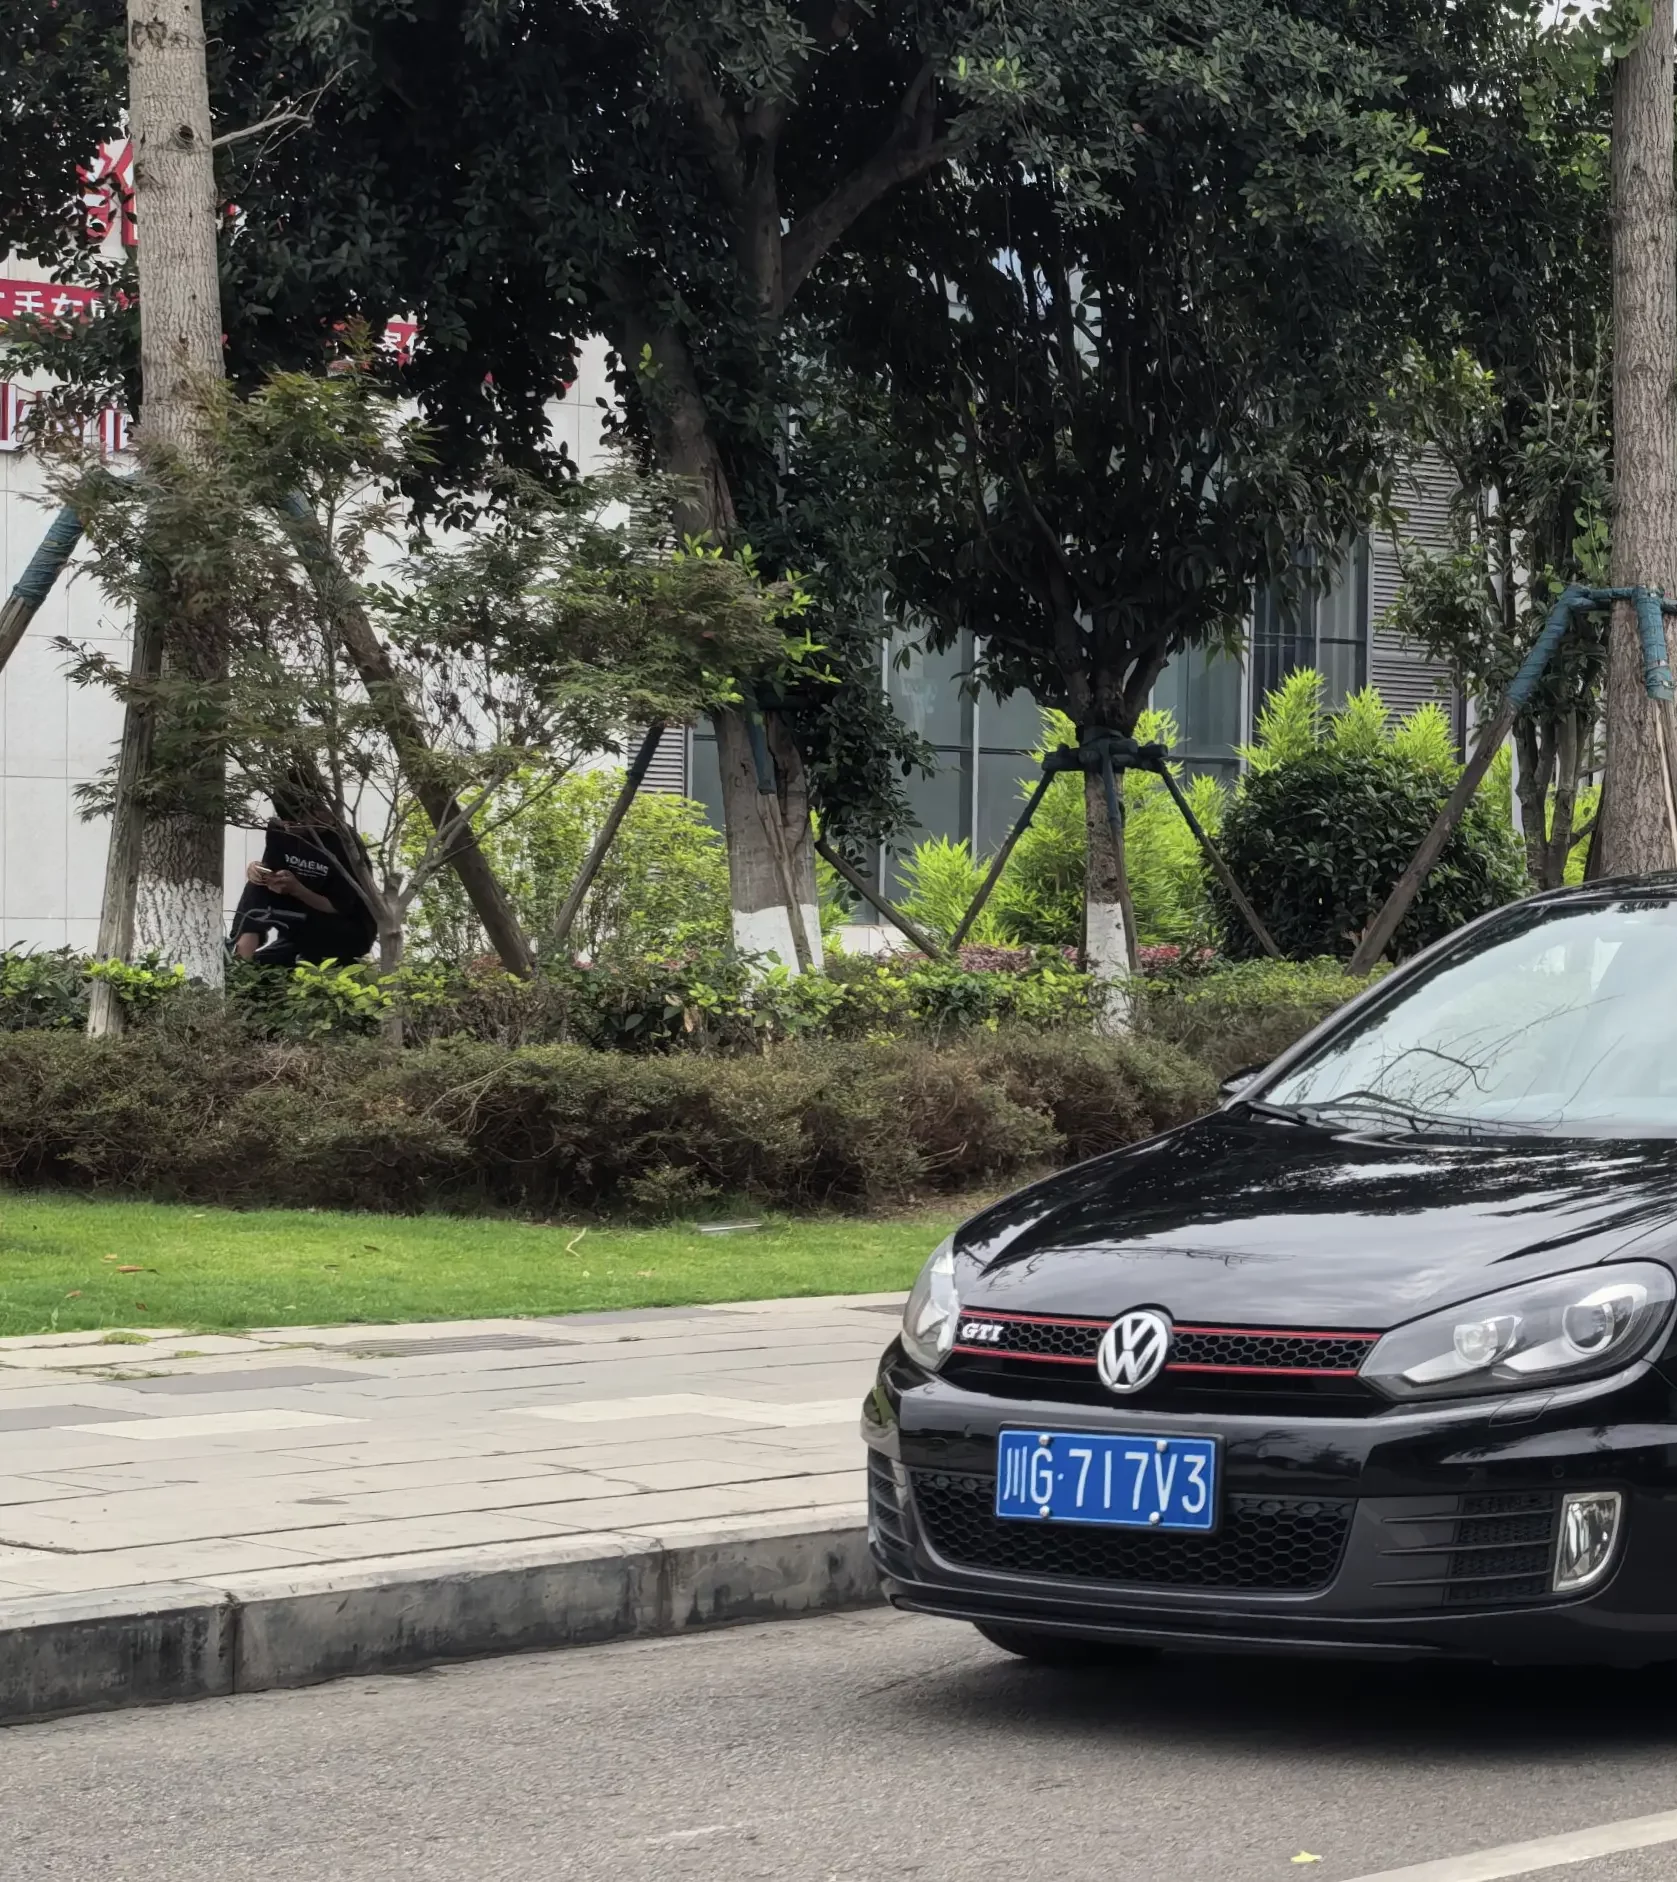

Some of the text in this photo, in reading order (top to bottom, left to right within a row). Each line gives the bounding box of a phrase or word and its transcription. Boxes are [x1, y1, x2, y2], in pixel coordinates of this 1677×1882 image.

[962, 1322, 1004, 1342] GTI
[1097, 1310, 1168, 1394] VW
[1003, 1446, 1206, 1513] 川G·717V3
